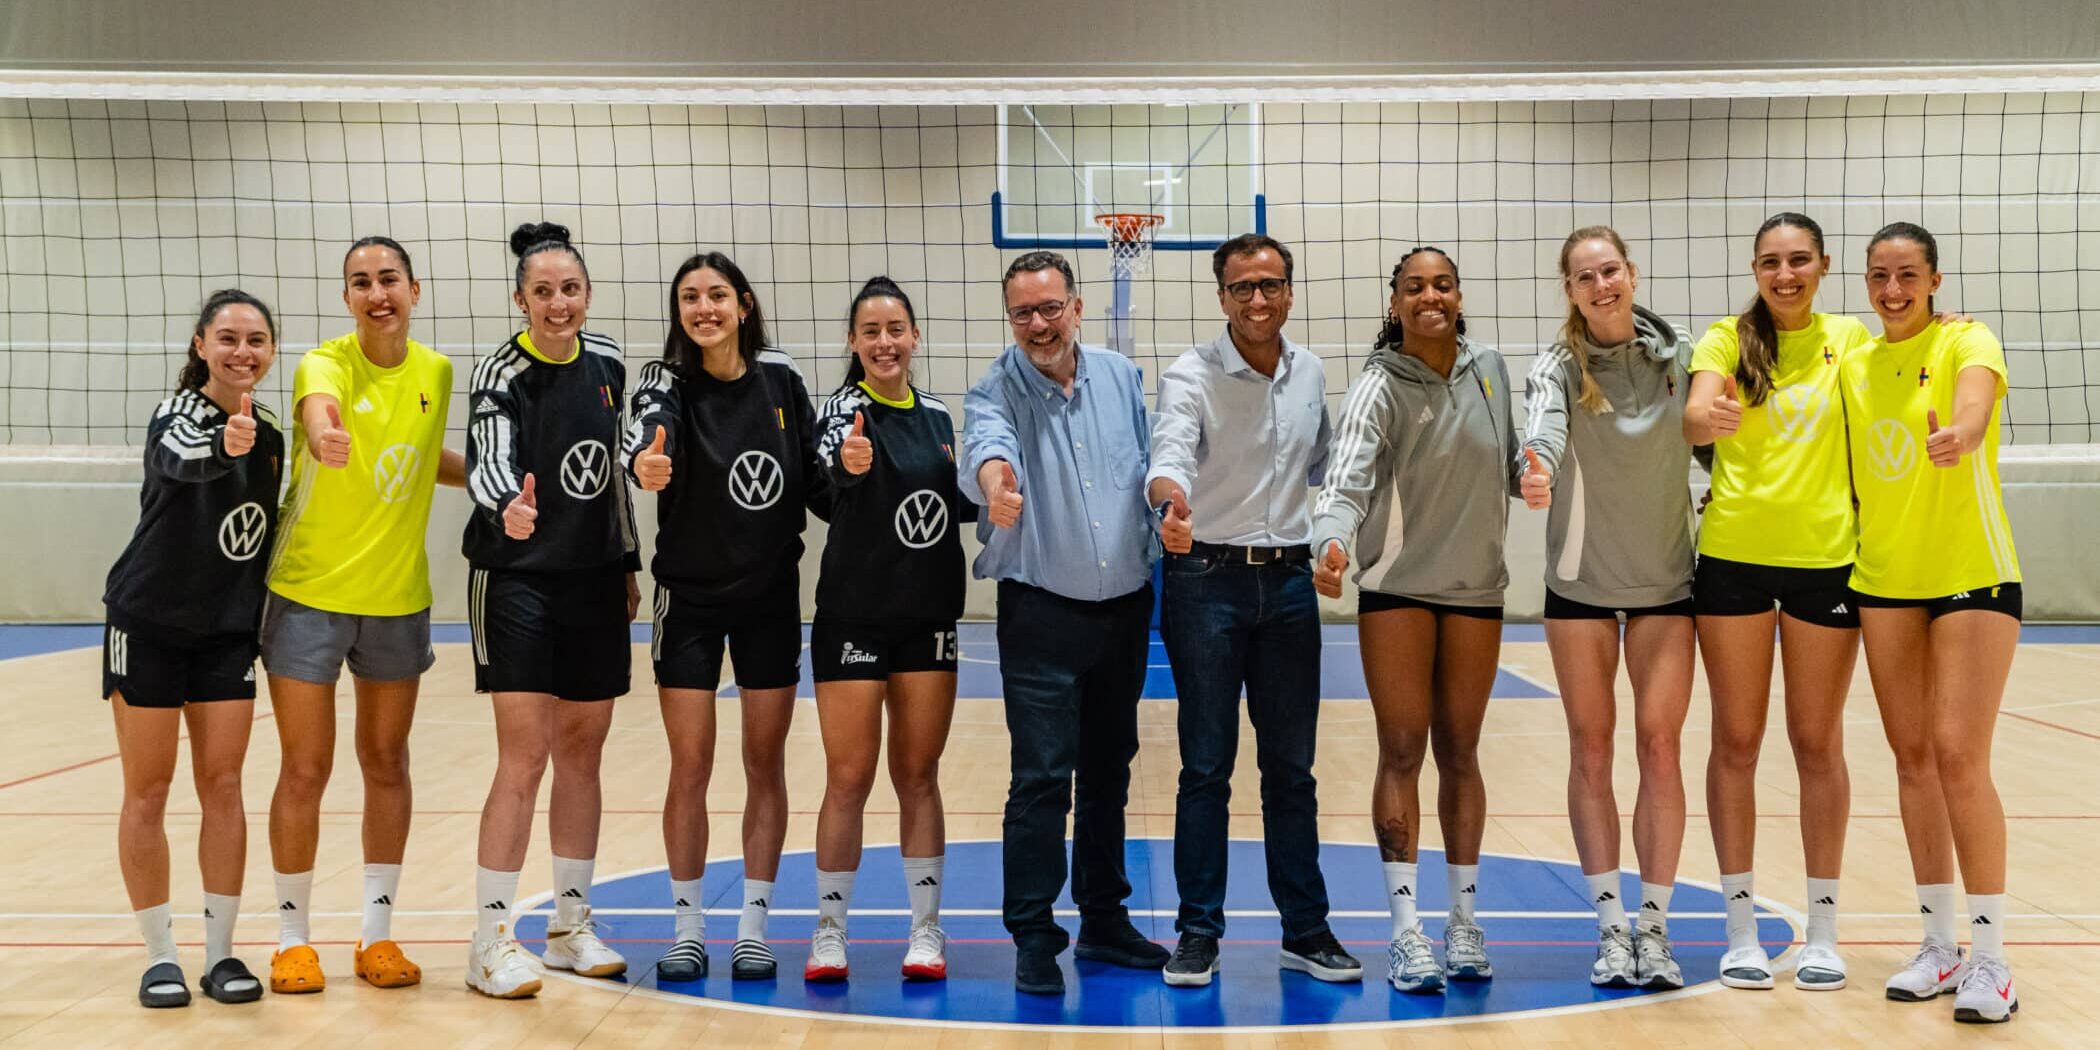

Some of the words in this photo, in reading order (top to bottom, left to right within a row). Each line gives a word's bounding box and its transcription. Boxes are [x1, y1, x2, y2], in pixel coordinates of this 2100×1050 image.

[376, 444, 419, 502] VW
[562, 441, 608, 498] VW
[730, 452, 782, 508] VW
[220, 503, 265, 559] VW
[896, 490, 946, 546] VW
[934, 631, 956, 661] 13
